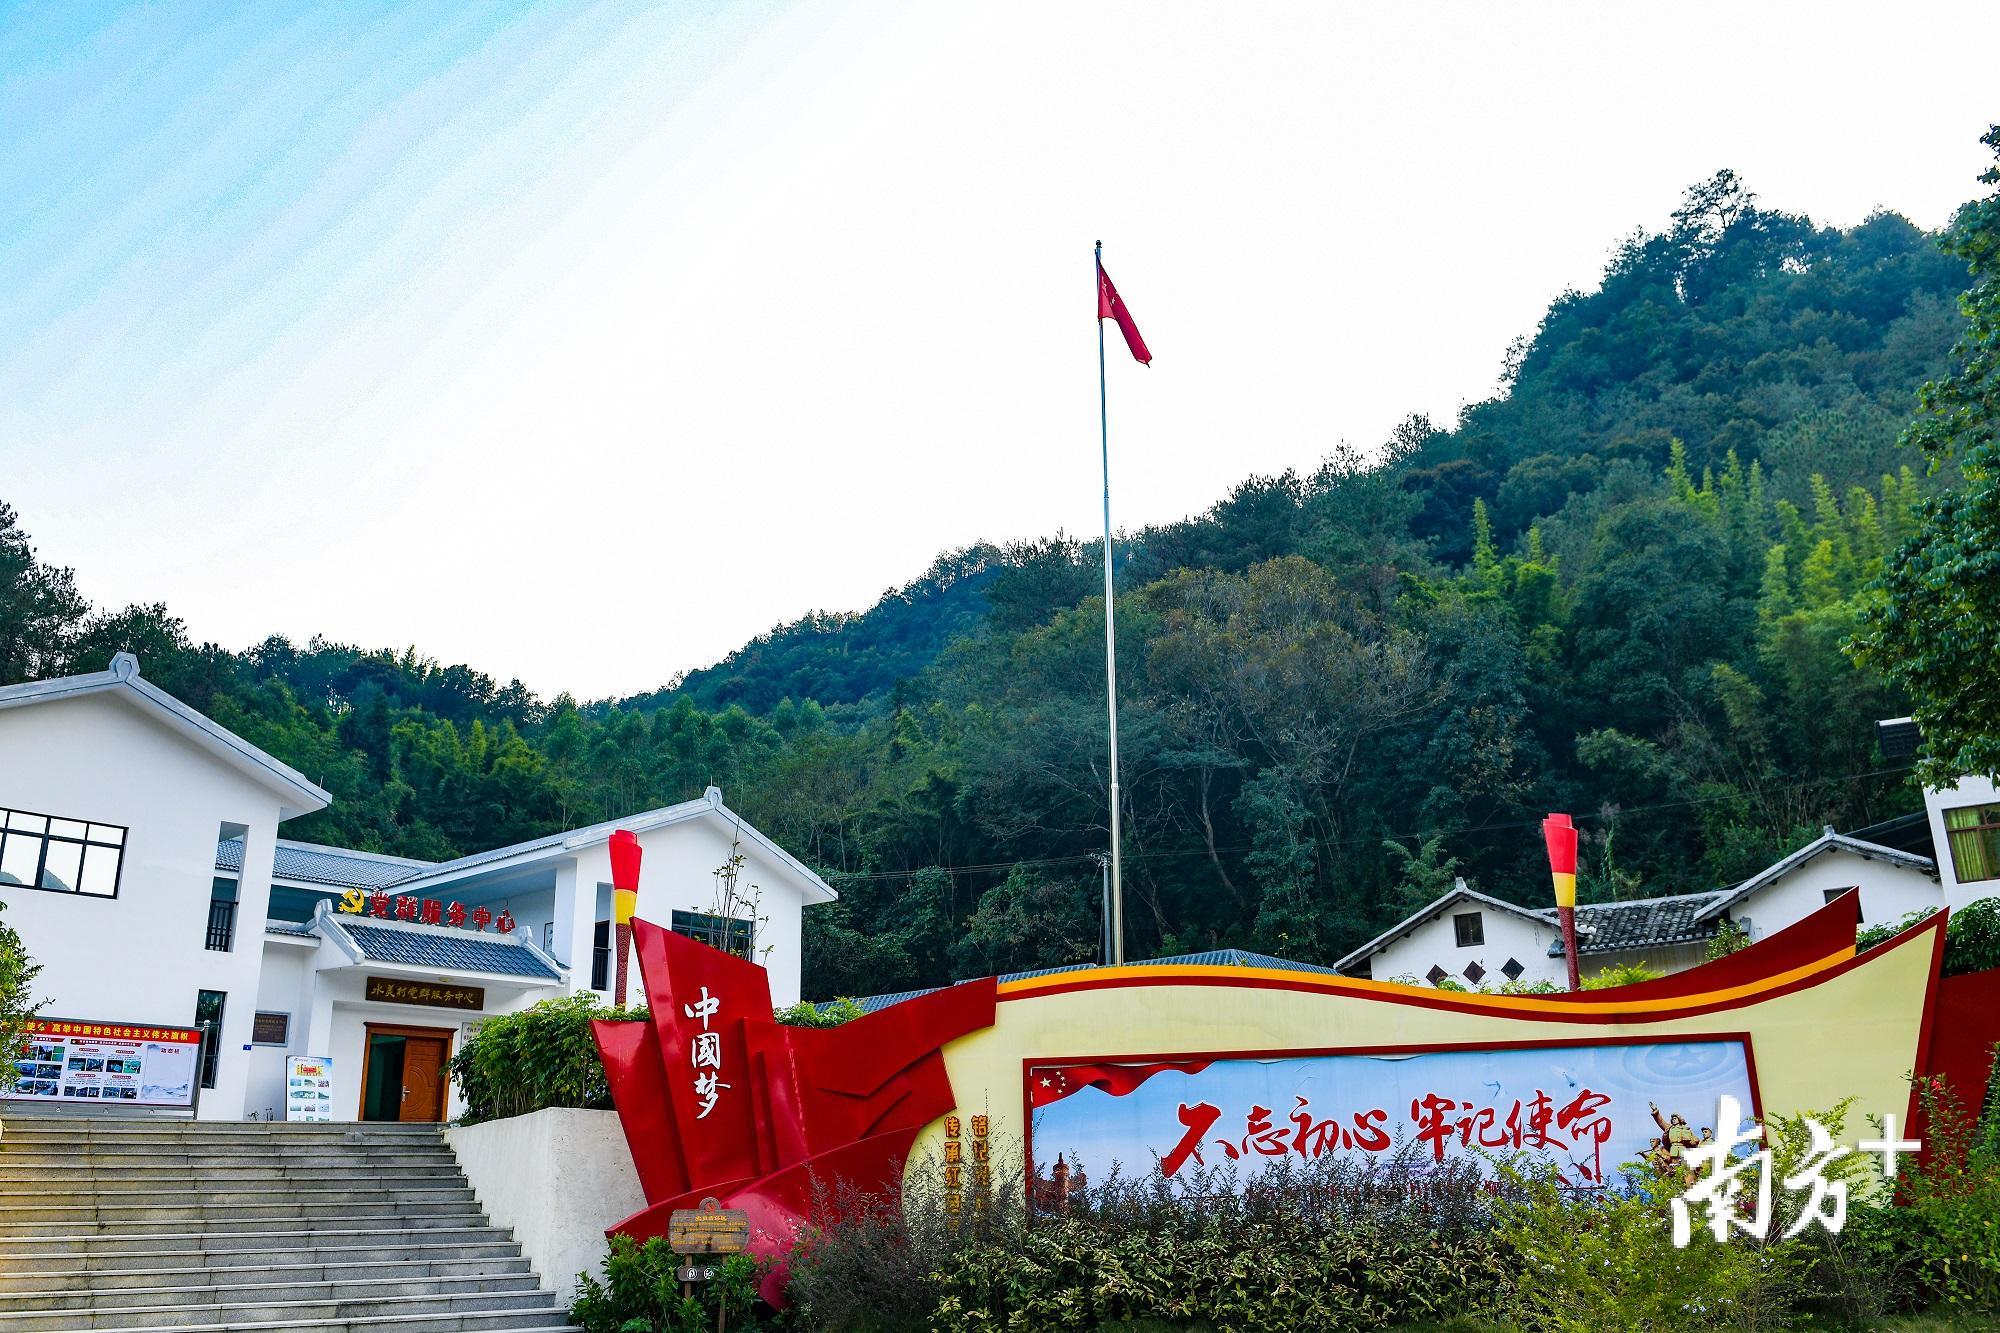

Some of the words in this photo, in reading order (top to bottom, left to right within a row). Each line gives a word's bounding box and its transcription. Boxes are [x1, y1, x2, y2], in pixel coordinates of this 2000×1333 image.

[368, 889, 516, 935] 党群服务中心
[371, 983, 474, 1004] 水美村党群服务中心
[52, 1023, 188, 1041] 高举中国特色社会主义伟大旗帜
[1161, 1096, 1390, 1178] 不忘初心
[1411, 1088, 1612, 1184] 牢记使命
